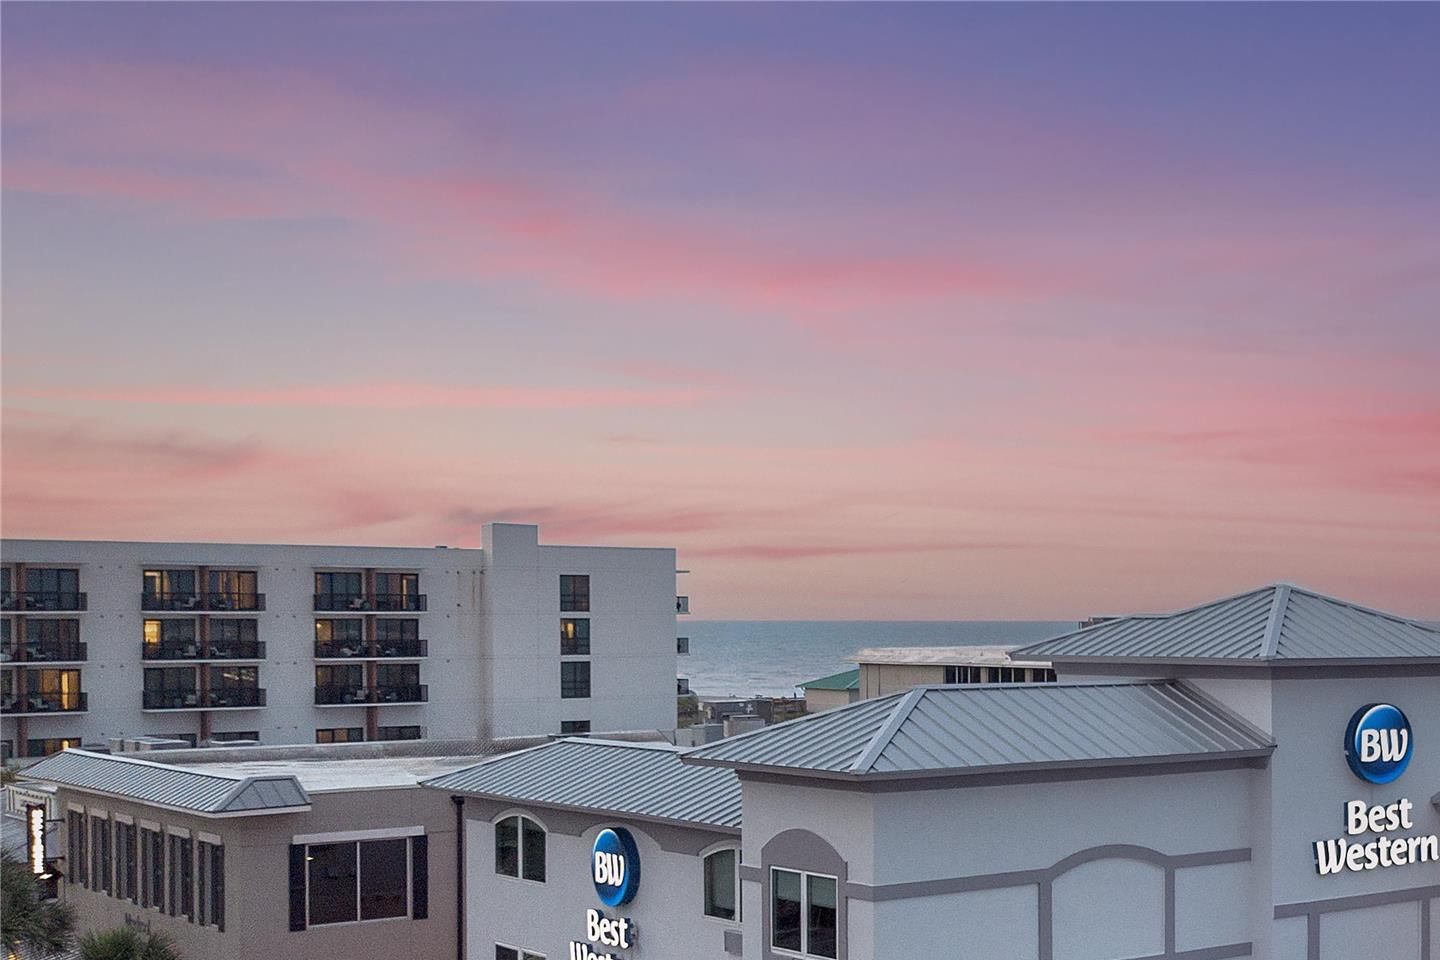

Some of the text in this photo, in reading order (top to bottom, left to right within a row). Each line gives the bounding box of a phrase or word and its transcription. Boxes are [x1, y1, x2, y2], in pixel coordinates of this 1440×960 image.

[1360, 728, 1409, 763] BW
[1347, 798, 1414, 835] Best
[594, 851, 625, 887] BW
[1315, 834, 1440, 876] Western
[586, 908, 629, 949] Best
